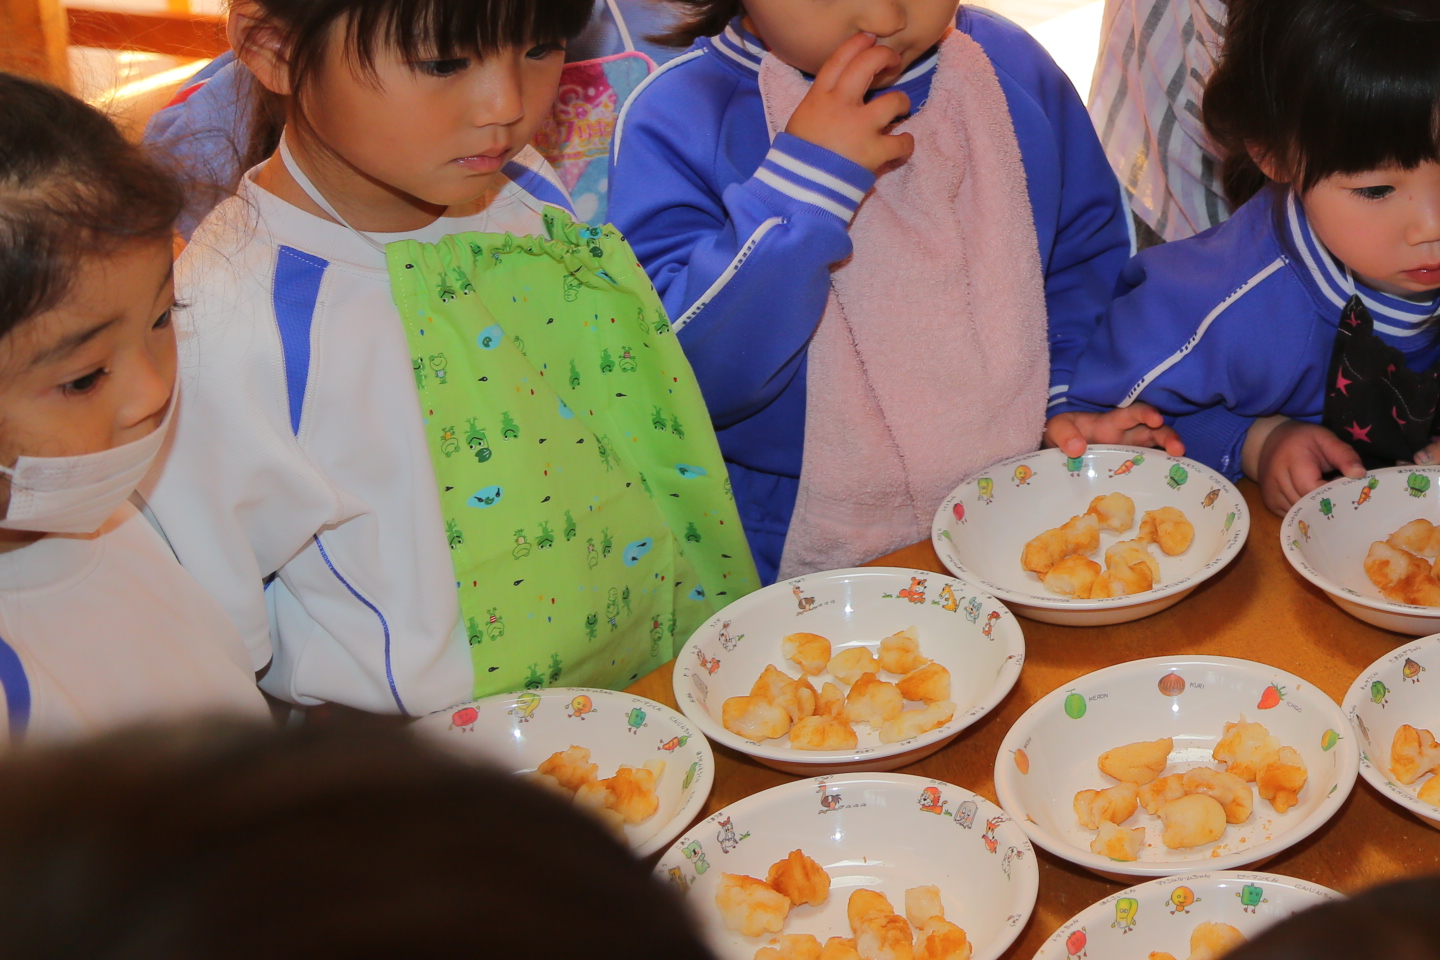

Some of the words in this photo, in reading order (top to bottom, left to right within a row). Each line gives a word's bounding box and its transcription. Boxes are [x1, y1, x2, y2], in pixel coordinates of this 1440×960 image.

[1189, 682, 1205, 690] KURI
[1088, 693, 1109, 702] MERON
[1286, 701, 1302, 713] ICHIGO
